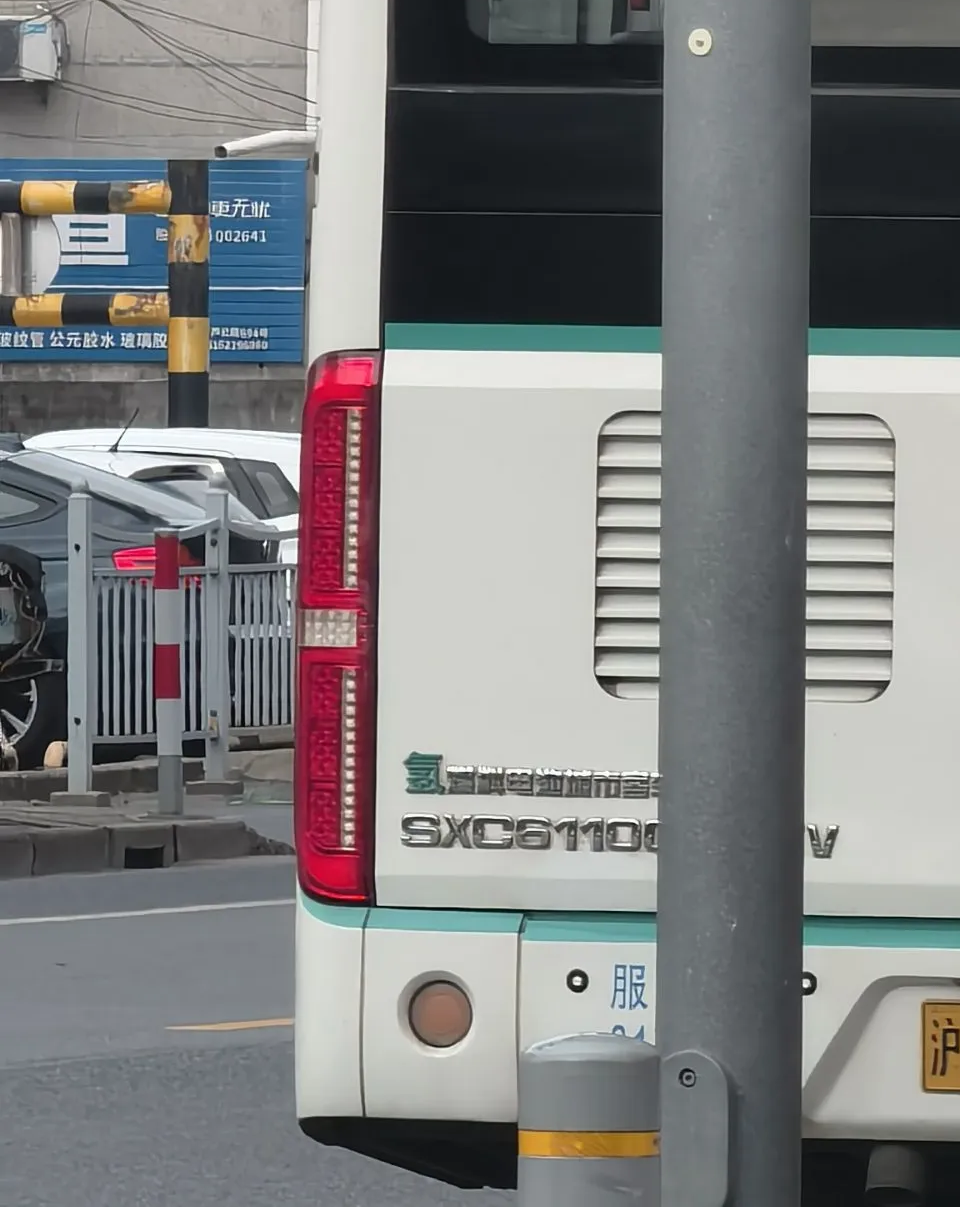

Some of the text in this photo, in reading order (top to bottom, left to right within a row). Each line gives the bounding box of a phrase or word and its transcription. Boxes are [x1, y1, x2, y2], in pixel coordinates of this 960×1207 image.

[50, 330, 116, 349] 公元胶水
[610, 963, 649, 1011] 服
